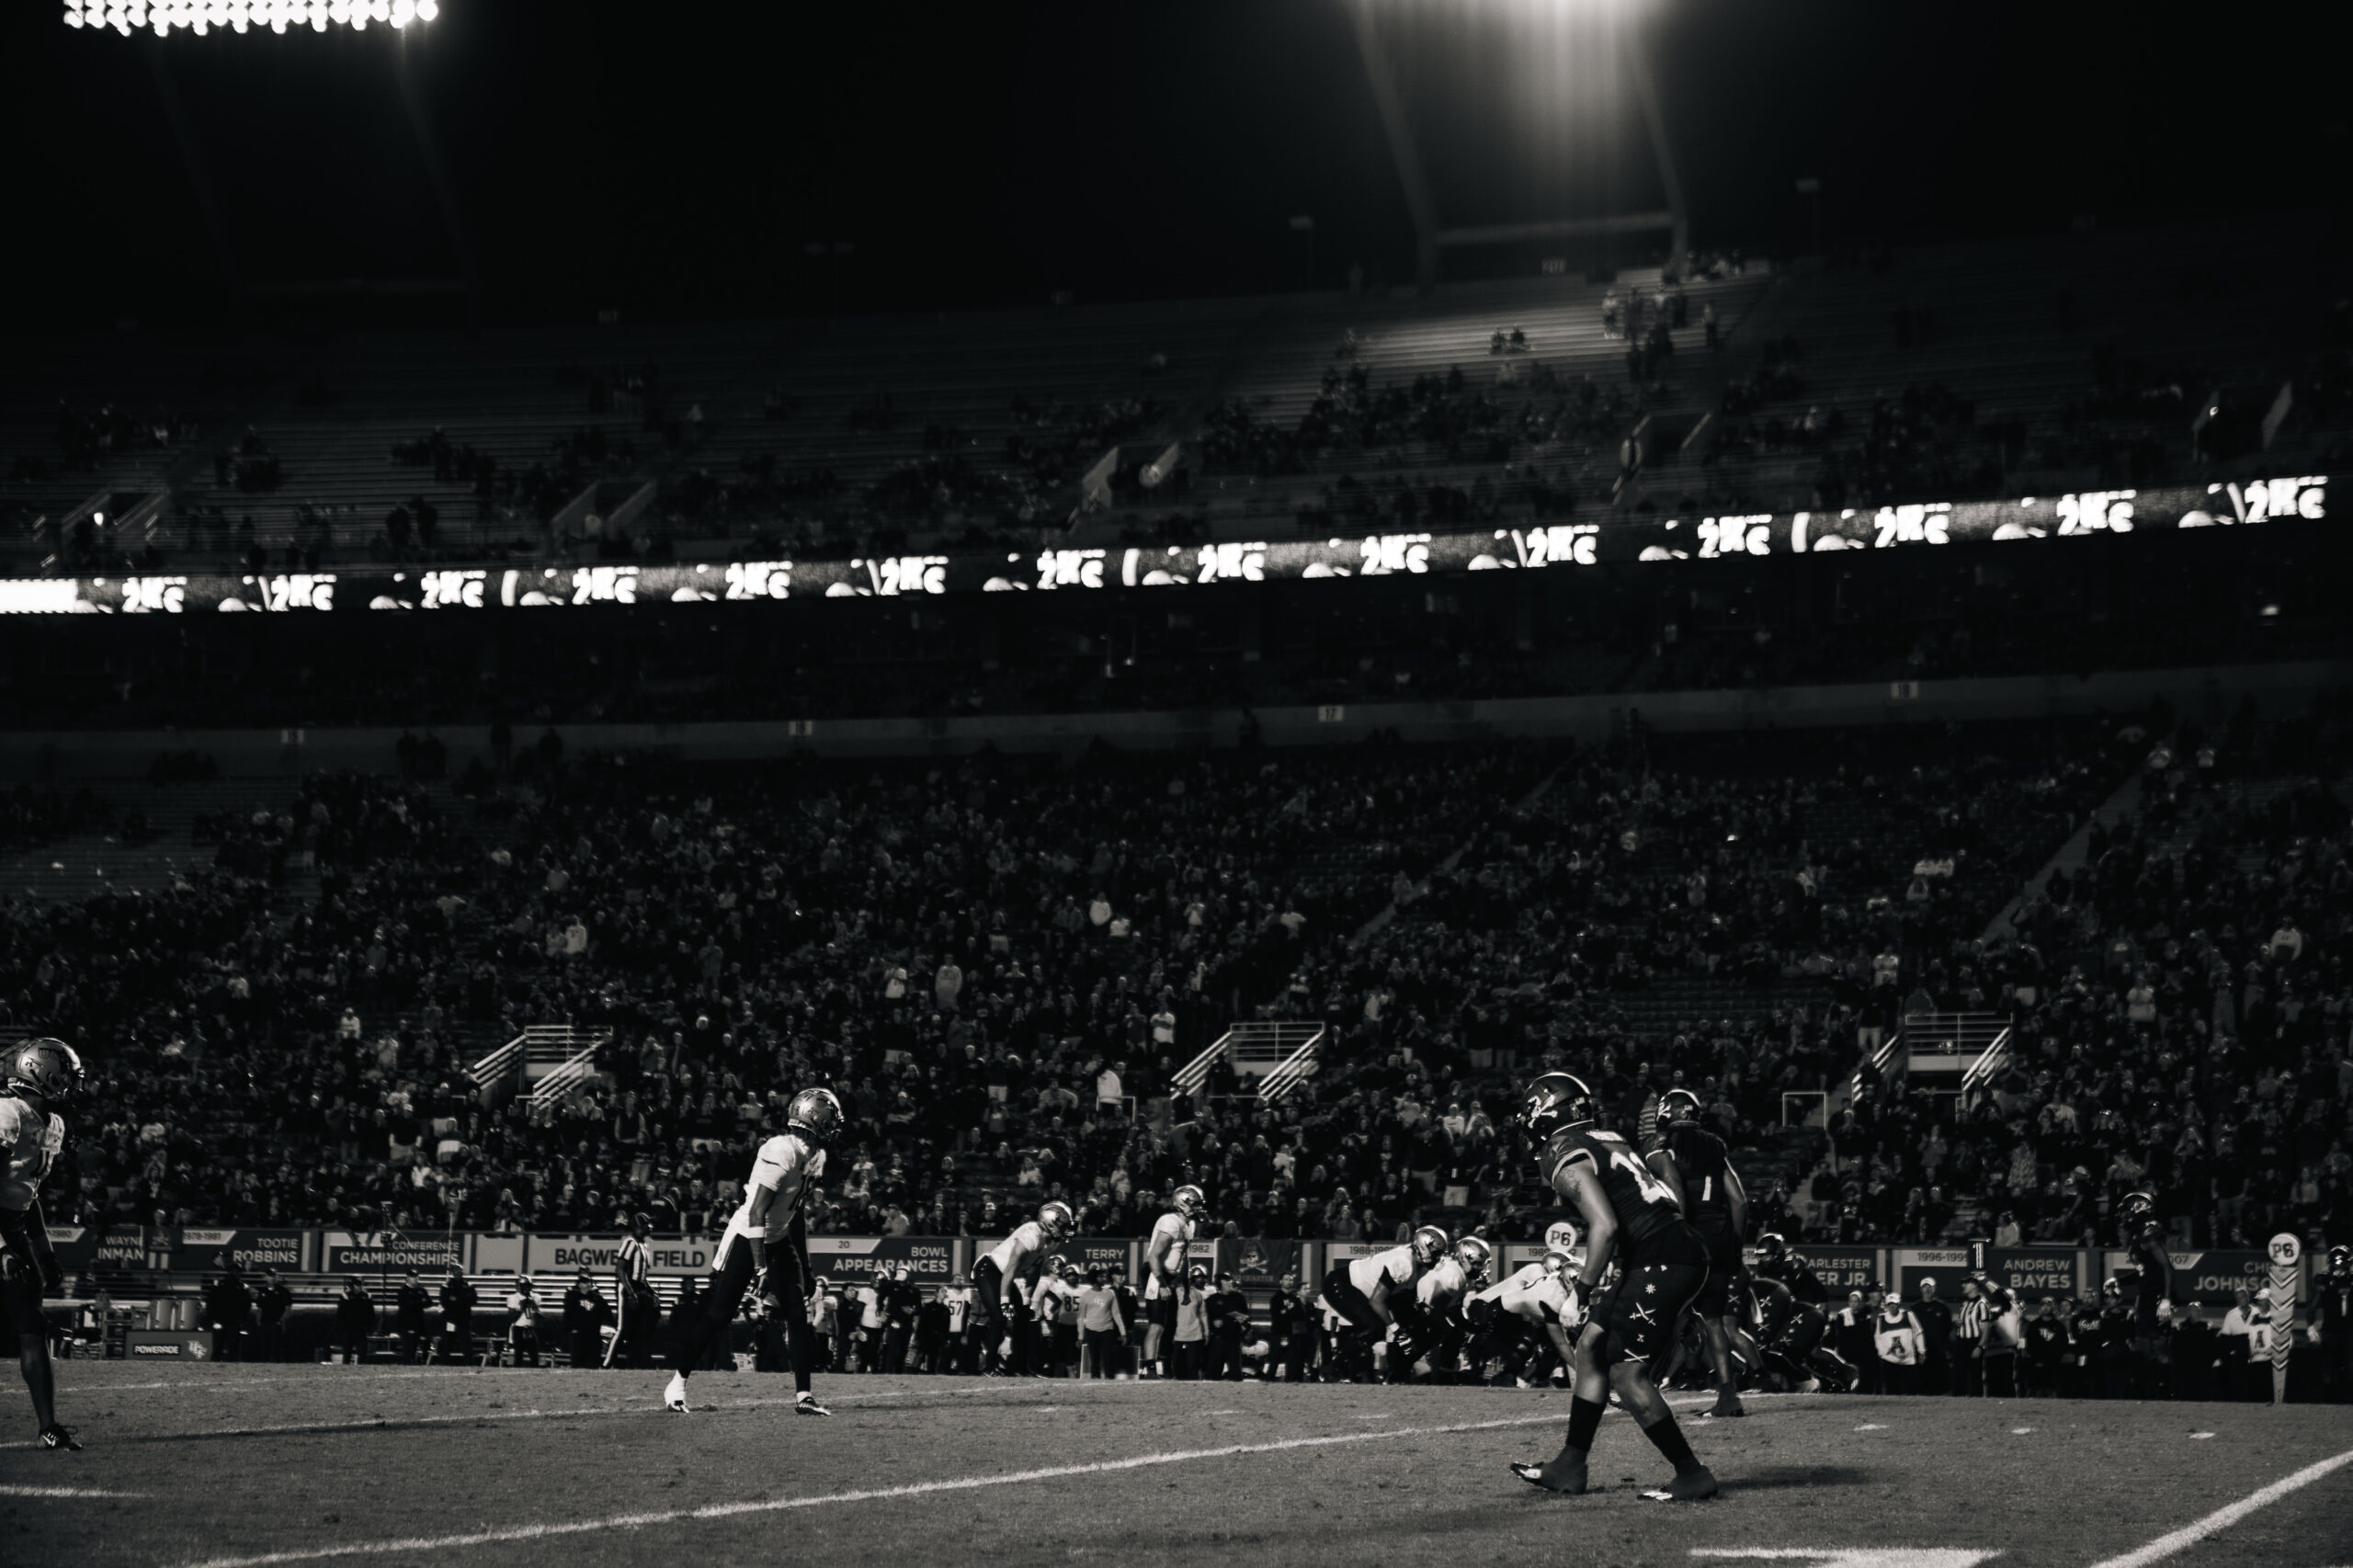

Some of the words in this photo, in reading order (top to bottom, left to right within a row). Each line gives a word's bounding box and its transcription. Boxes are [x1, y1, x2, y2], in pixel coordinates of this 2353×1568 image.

[106, 1235, 143, 1246] WAYN
[256, 1238, 299, 1249] TOOTIE
[392, 1241, 460, 1251] CONFERENCE
[838, 1241, 850, 1249] 20
[97, 1247, 145, 1260] INMAN
[233, 1250, 298, 1263] ROBBINS
[554, 1248, 620, 1266] BAGWE
[654, 1251, 705, 1267] FIELD
[911, 1246, 949, 1257] BOWL
[1085, 1248, 1125, 1260] TERRY
[340, 1251, 459, 1266] CHAMPIONSHIPS
[1807, 1258, 1871, 1269] ARLESTER
[833, 1258, 949, 1273] APPEARANCES
[2003, 1259, 2070, 1271] ANDREW
[2010, 1274, 2071, 1289] BAYES
[2194, 1276, 2270, 1291] JOHNSO
[1064, 1296, 1080, 1312] 85
[133, 1345, 179, 1354] POWERADE
